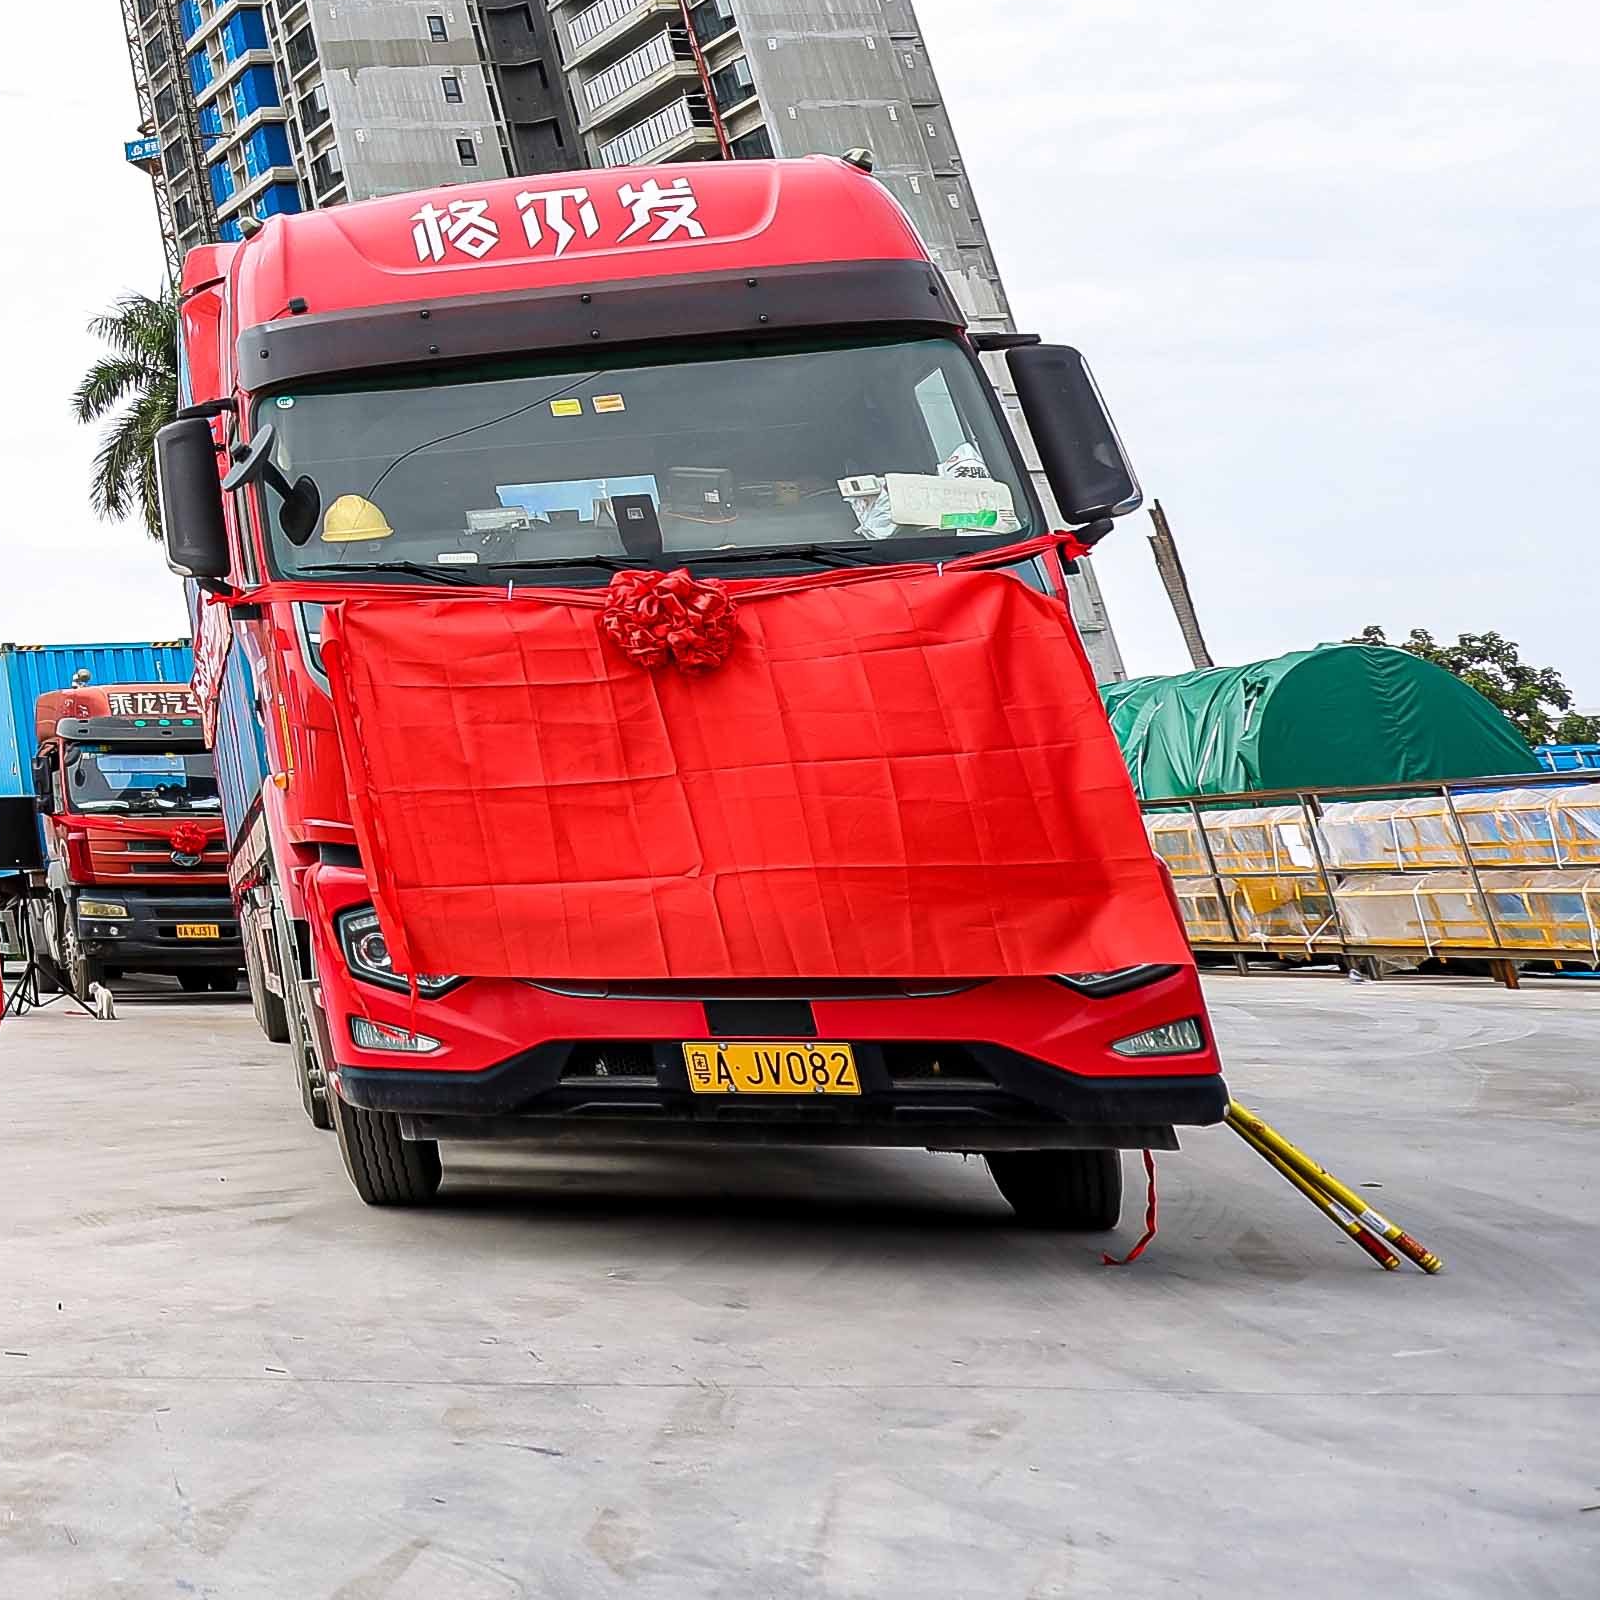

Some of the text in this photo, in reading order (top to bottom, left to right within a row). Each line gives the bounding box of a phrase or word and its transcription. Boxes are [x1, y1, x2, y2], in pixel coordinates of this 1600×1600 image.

[409, 177, 706, 263] 格尔发
[692, 1051, 855, 1087] 粤A·JV082
